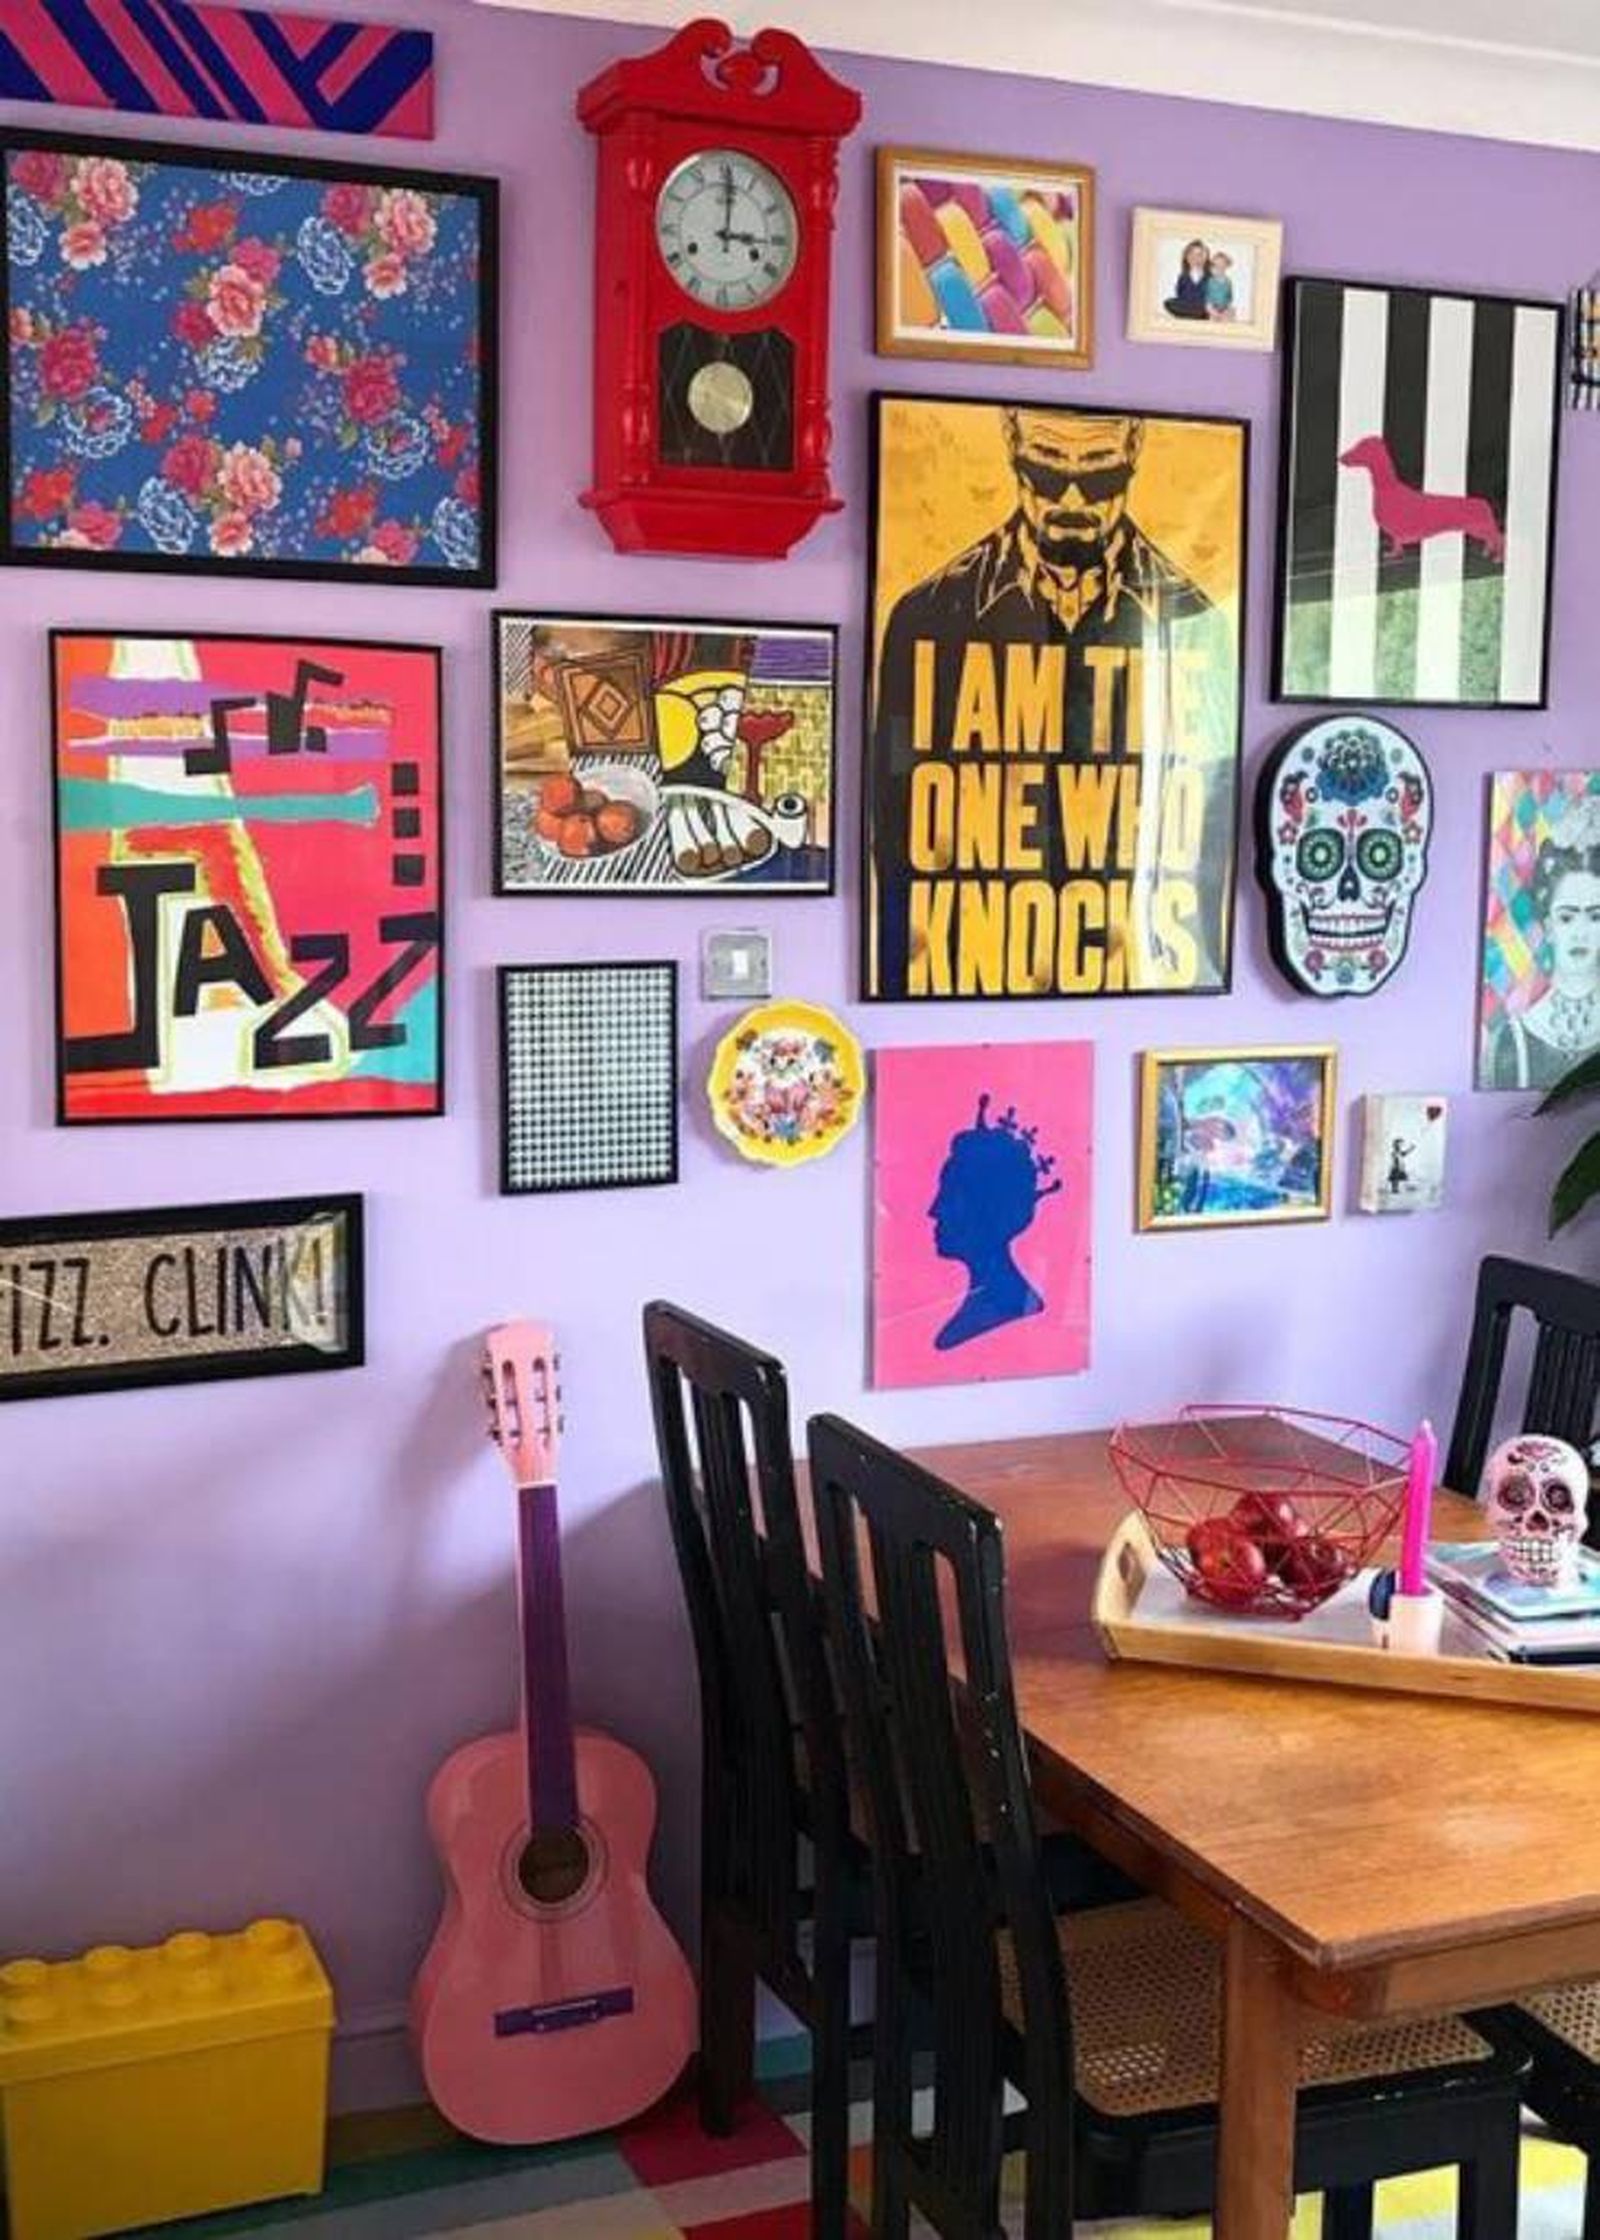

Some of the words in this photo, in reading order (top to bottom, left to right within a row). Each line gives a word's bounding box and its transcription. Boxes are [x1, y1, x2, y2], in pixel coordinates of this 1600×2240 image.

[912, 640, 936, 752] I
[952, 640, 1067, 753] AM
[910, 761, 1046, 872] ONE
[64, 862, 437, 1072] JAZZ
[0, 1258, 110, 1356] IZZ.
[143, 1236, 328, 1340] CLINK!
